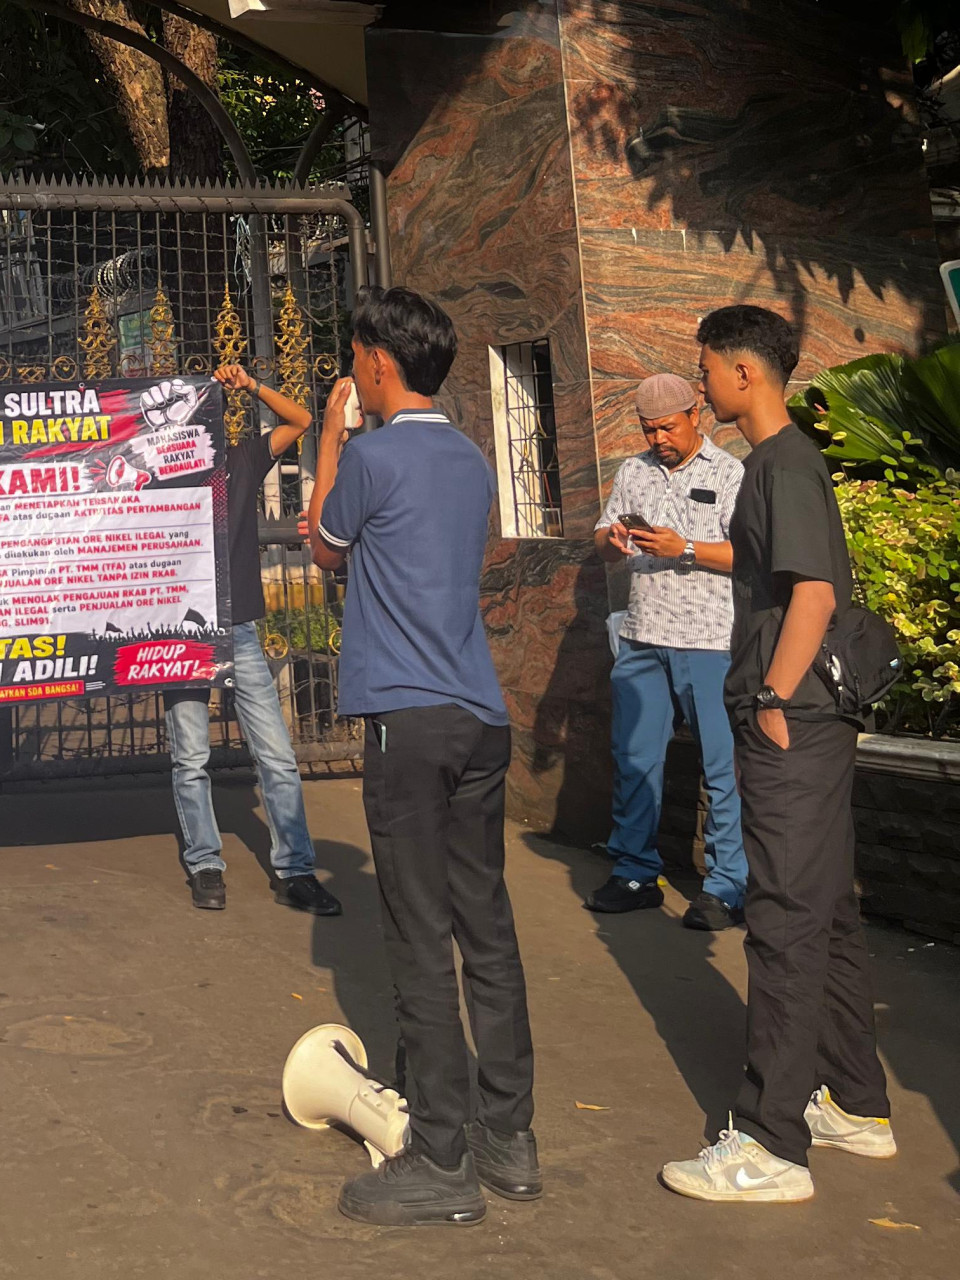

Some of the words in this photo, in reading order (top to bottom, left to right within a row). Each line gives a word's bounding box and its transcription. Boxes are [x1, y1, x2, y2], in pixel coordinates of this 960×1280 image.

[4, 389, 100, 417] SULTRA
[12, 415, 111, 444] RAKYAT
[147, 428, 200, 447] MAHASISWA
[156, 440, 197, 455] BERSUARA
[163, 450, 195, 464] RAKYAT
[12, 512, 33, 521] atas
[35, 510, 71, 522] dugaan
[126, 502, 201, 514] PERTAMBANGAN
[82, 535, 102, 544] ORE
[105, 533, 133, 542] NIKEL
[135, 530, 166, 540] ILEGAL
[168, 530, 189, 540] yang
[54, 547, 75, 556] oleh
[77, 543, 138, 555] MANAJEMEN
[141, 538, 204, 550] PERUSAHAAN.
[58, 565, 73, 574] PT.
[75, 563, 99, 573] TMM
[102, 562, 127, 573] (TFA)
[129, 560, 148, 569] atas
[150, 558, 182, 570] dugaan
[43, 576, 64, 585] ORE
[66, 574, 95, 584] NIKEL
[97, 572, 128, 582] TANPA
[130, 571, 149, 580] IZIN
[152, 569, 178, 578] RKAB.
[12, 594, 60, 605] MENOLAK
[63, 590, 120, 601] PENGAJUAN
[122, 588, 147, 597] RKAB
[150, 586, 163, 595] PT.
[165, 584, 189, 596] TMM,
[15, 605, 49, 615] ILEGAL
[52, 604, 77, 613] serta
[79, 598, 133, 610] PENJUALAN
[136, 597, 154, 606] ORE
[156, 594, 182, 604] NIKEL
[136, 644, 186, 662] HIDUP
[13, 655, 98, 682] ADILI!
[127, 660, 200, 680] RAKYAT!
[45, 683, 79, 694] BANGSA!
